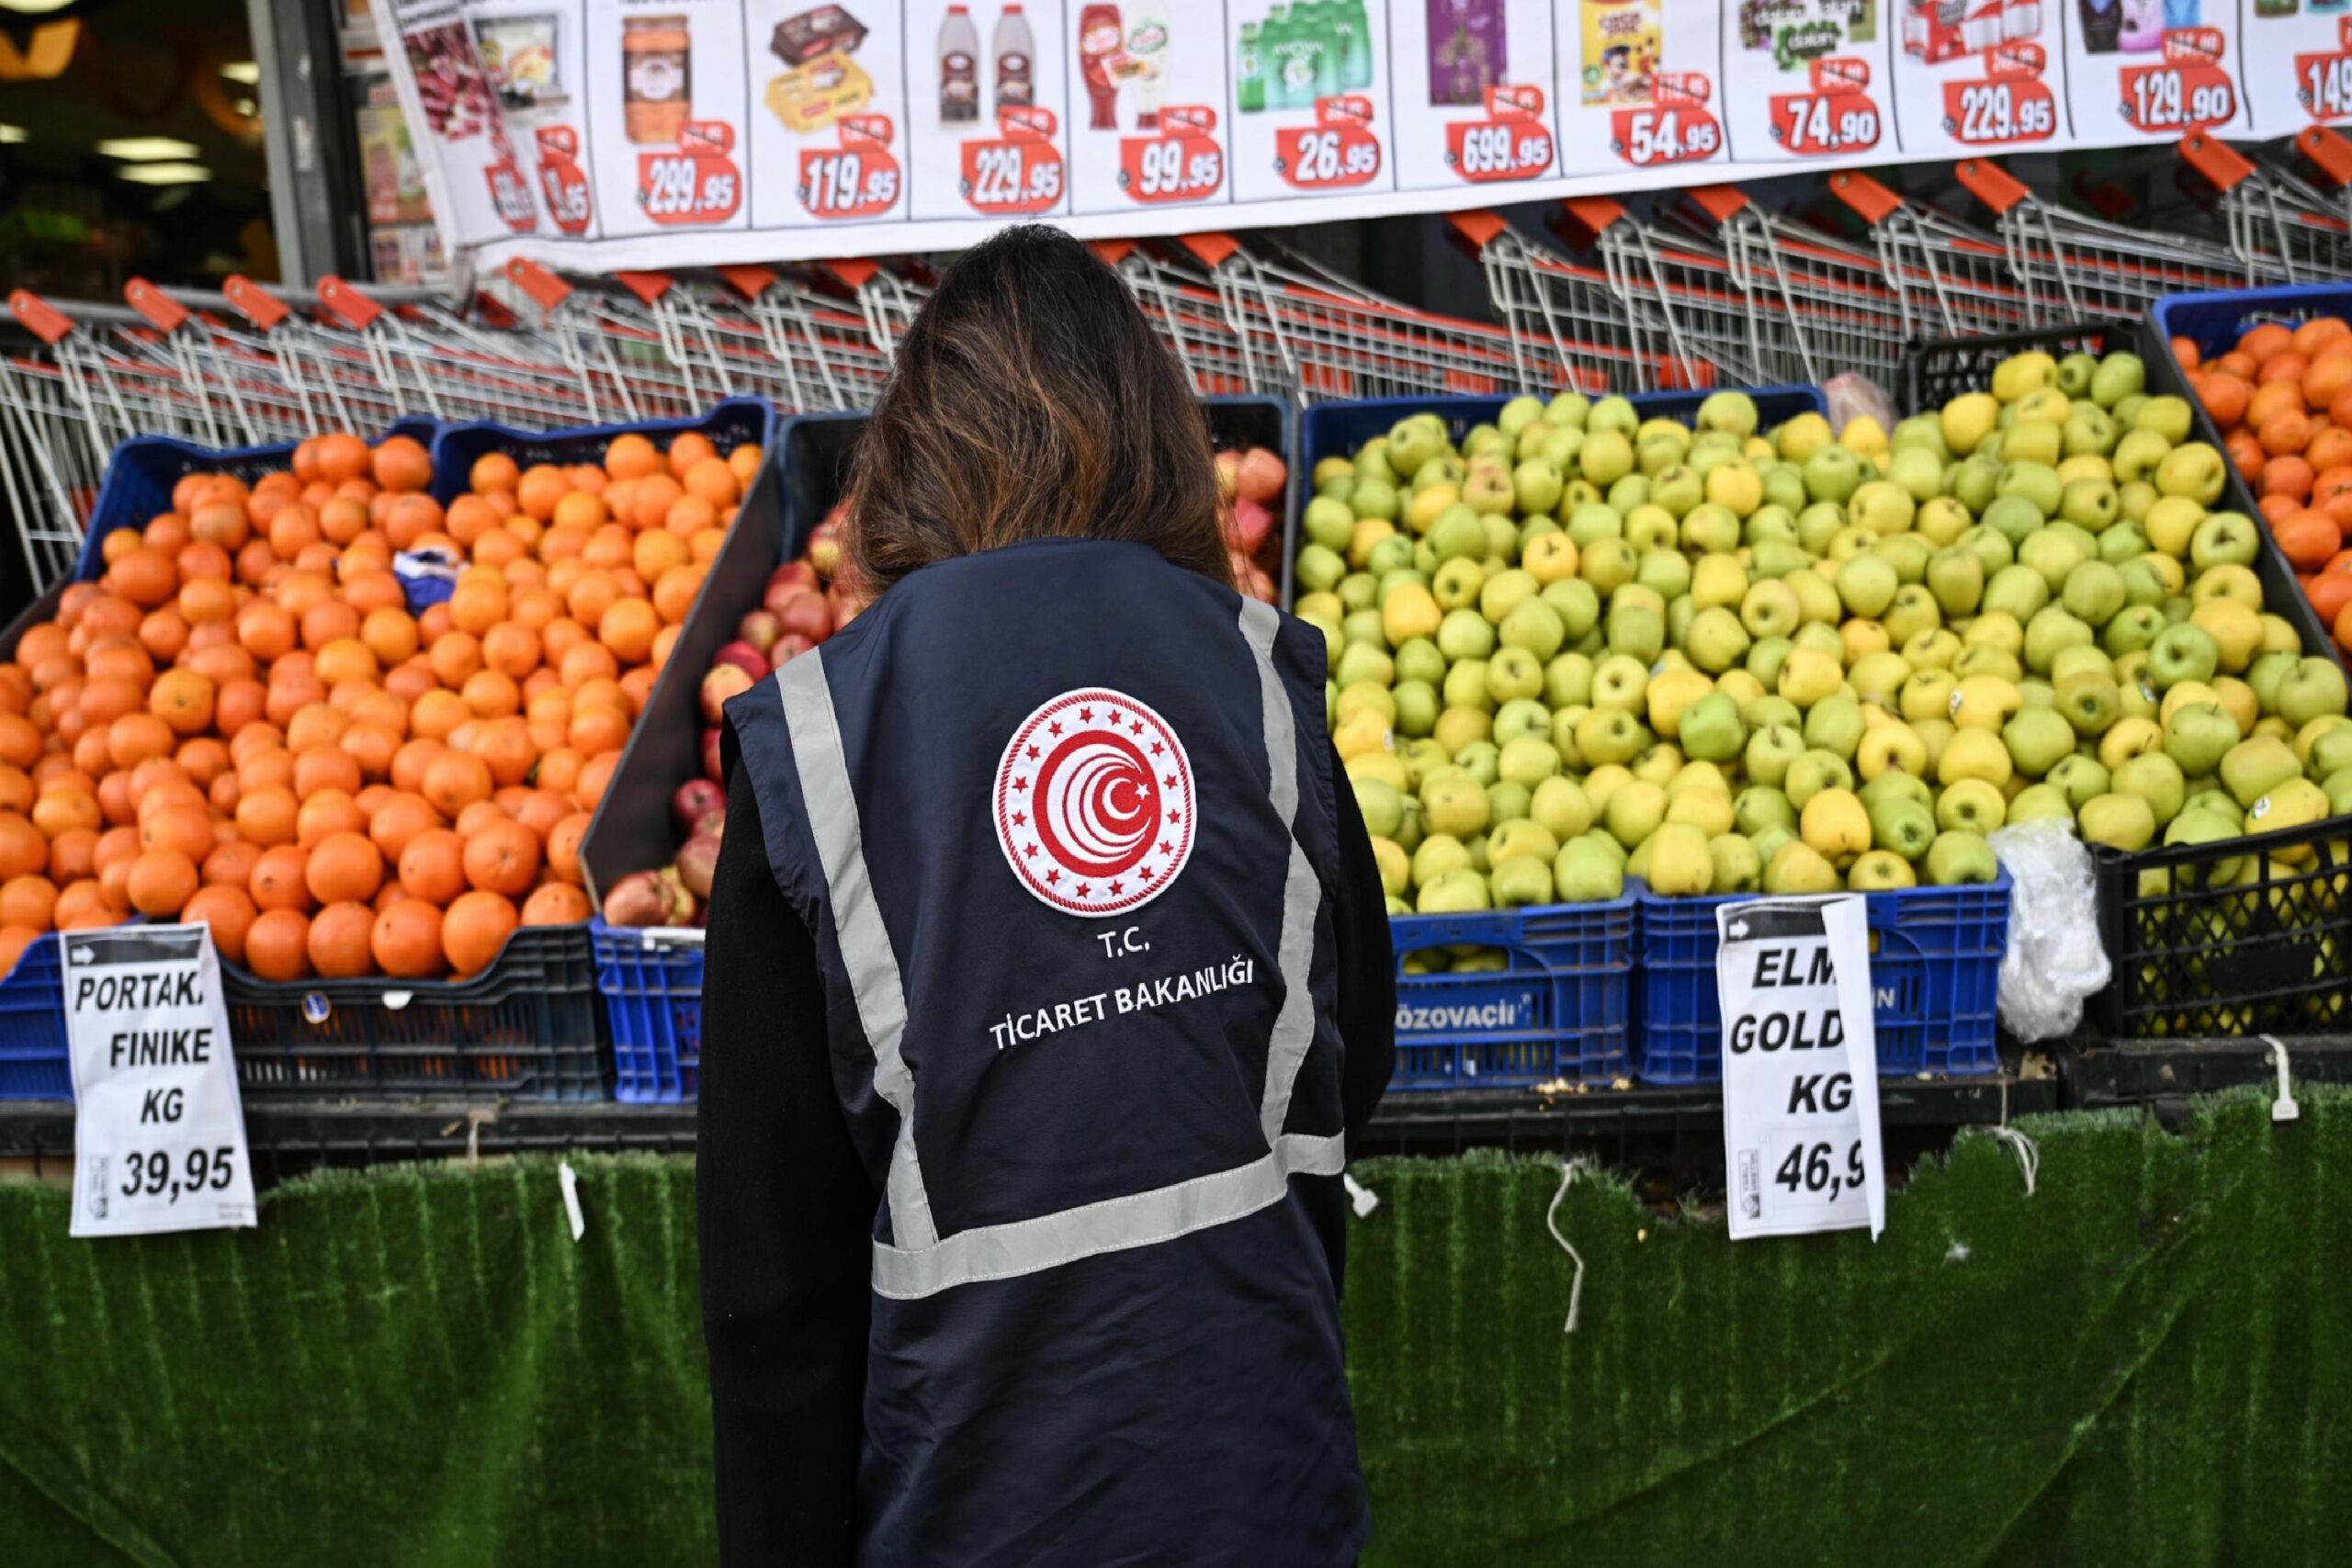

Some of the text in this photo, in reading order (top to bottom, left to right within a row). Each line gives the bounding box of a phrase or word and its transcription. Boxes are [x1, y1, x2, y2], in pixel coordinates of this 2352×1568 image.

[1787, 96, 1876, 150] 74,90
[1961, 84, 2051, 140] 229,95
[2133, 70, 2229, 126] 129,90
[1295, 130, 1376, 182] 26,95
[1462, 125, 1549, 174] 699,95
[1629, 110, 1715, 164] 54,95
[649, 157, 735, 215] 299,95
[807, 153, 898, 213] 119,95
[973, 146, 1060, 205] 229,95
[1139, 140, 1220, 196] 99,95
[1097, 926, 1150, 958] T.C.
[75, 971, 204, 1011] PORTAK
[989, 953, 1254, 1050] TİCARET BAKANLIĞI
[109, 1028, 213, 1067] FINIKE
[1730, 1010, 1846, 1055] GOLD
[140, 1089, 184, 1125] KG
[1787, 1072, 1853, 1115] KG
[120, 1146, 235, 1205] 39,95
